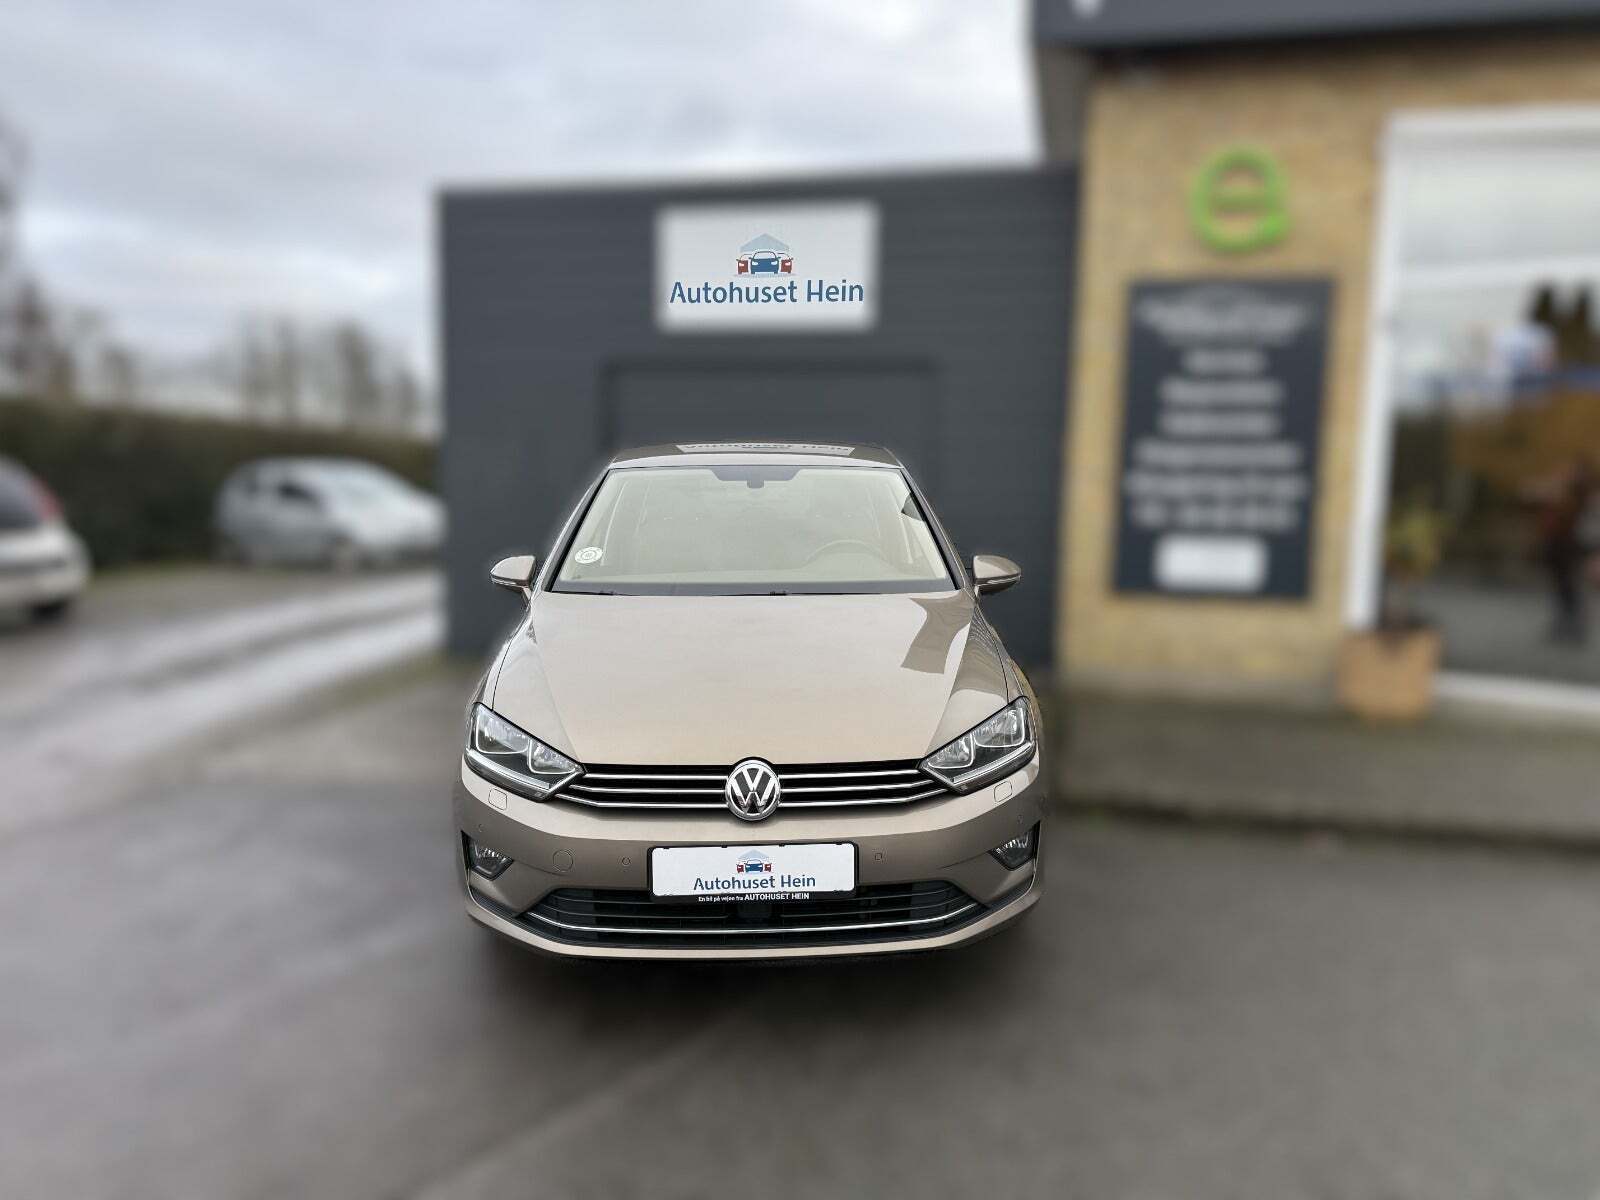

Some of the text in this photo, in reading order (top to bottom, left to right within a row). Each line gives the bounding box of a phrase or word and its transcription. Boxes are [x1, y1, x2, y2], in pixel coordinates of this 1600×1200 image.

[670, 279, 864, 304] Autohuset Hein
[693, 874, 816, 891] Autohuset Hein
[744, 893, 790, 901] AUTOHUSET
